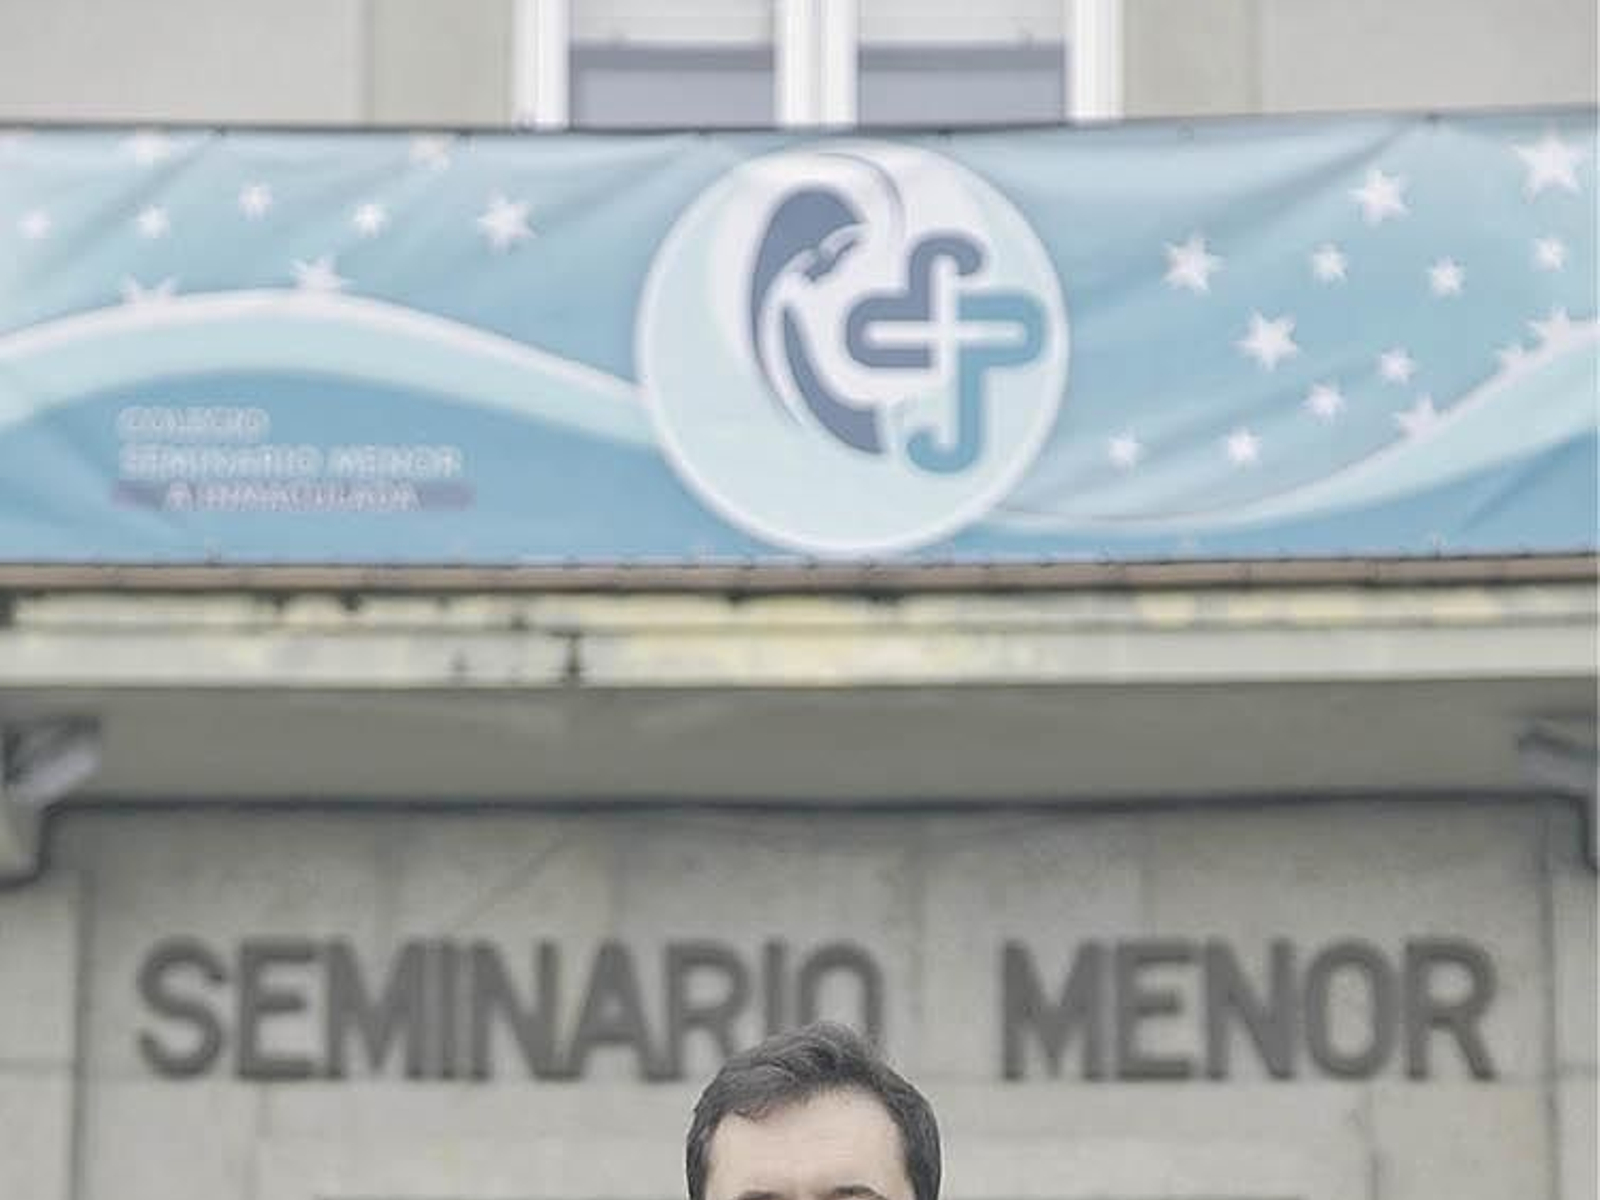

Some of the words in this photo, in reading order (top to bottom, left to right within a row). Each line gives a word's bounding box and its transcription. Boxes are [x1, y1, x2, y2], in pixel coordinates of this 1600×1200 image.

[119, 444, 324, 479] SEMINARIO
[327, 444, 464, 479] MENOR
[135, 936, 886, 1083] SEMINARIO
[1001, 938, 1497, 1083] MENOR
